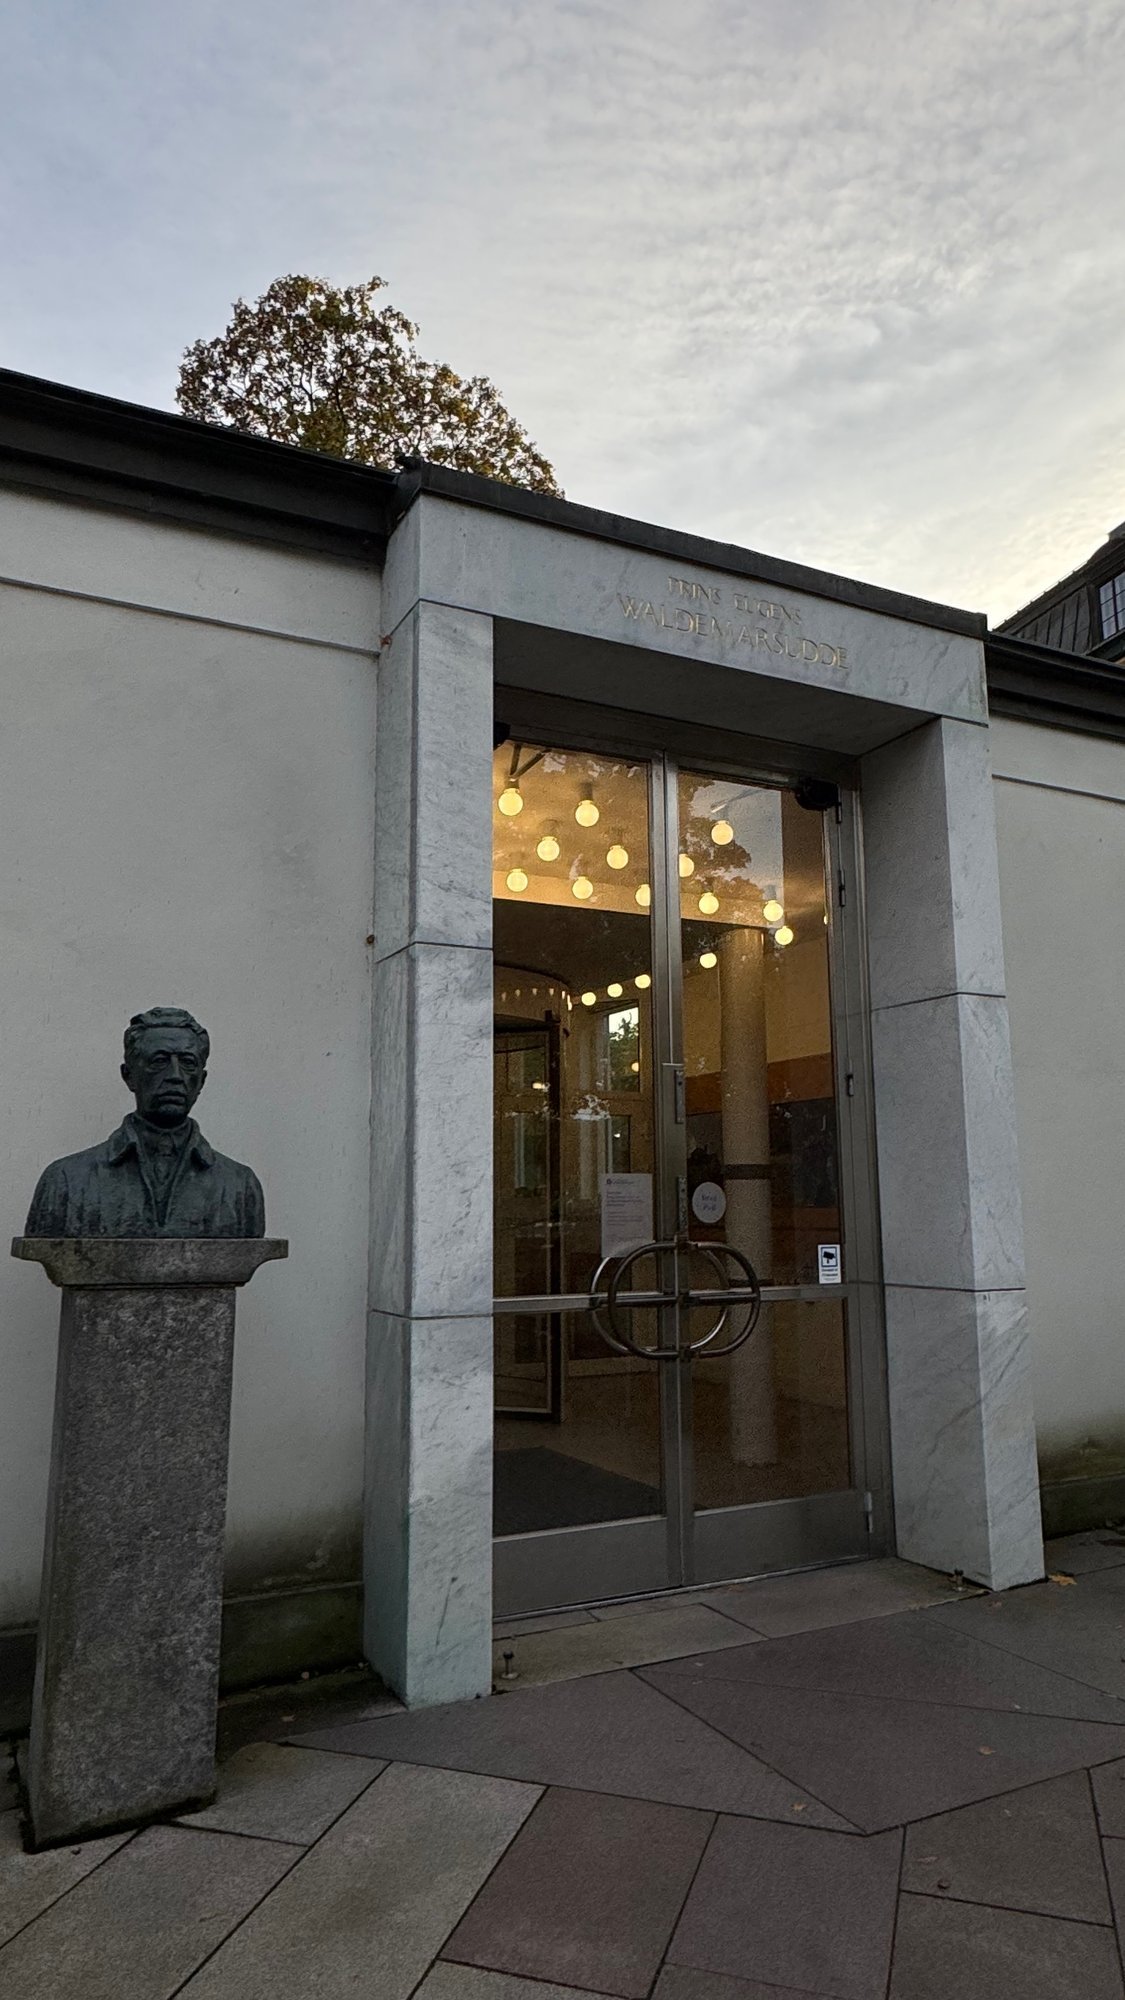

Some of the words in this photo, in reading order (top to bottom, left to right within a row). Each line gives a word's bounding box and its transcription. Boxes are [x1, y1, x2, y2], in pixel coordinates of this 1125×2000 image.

[617, 593, 849, 669] WALDEMARSUDDE
[668, 576, 721, 605] PRINS
[733, 593, 802, 625] EUGENS
